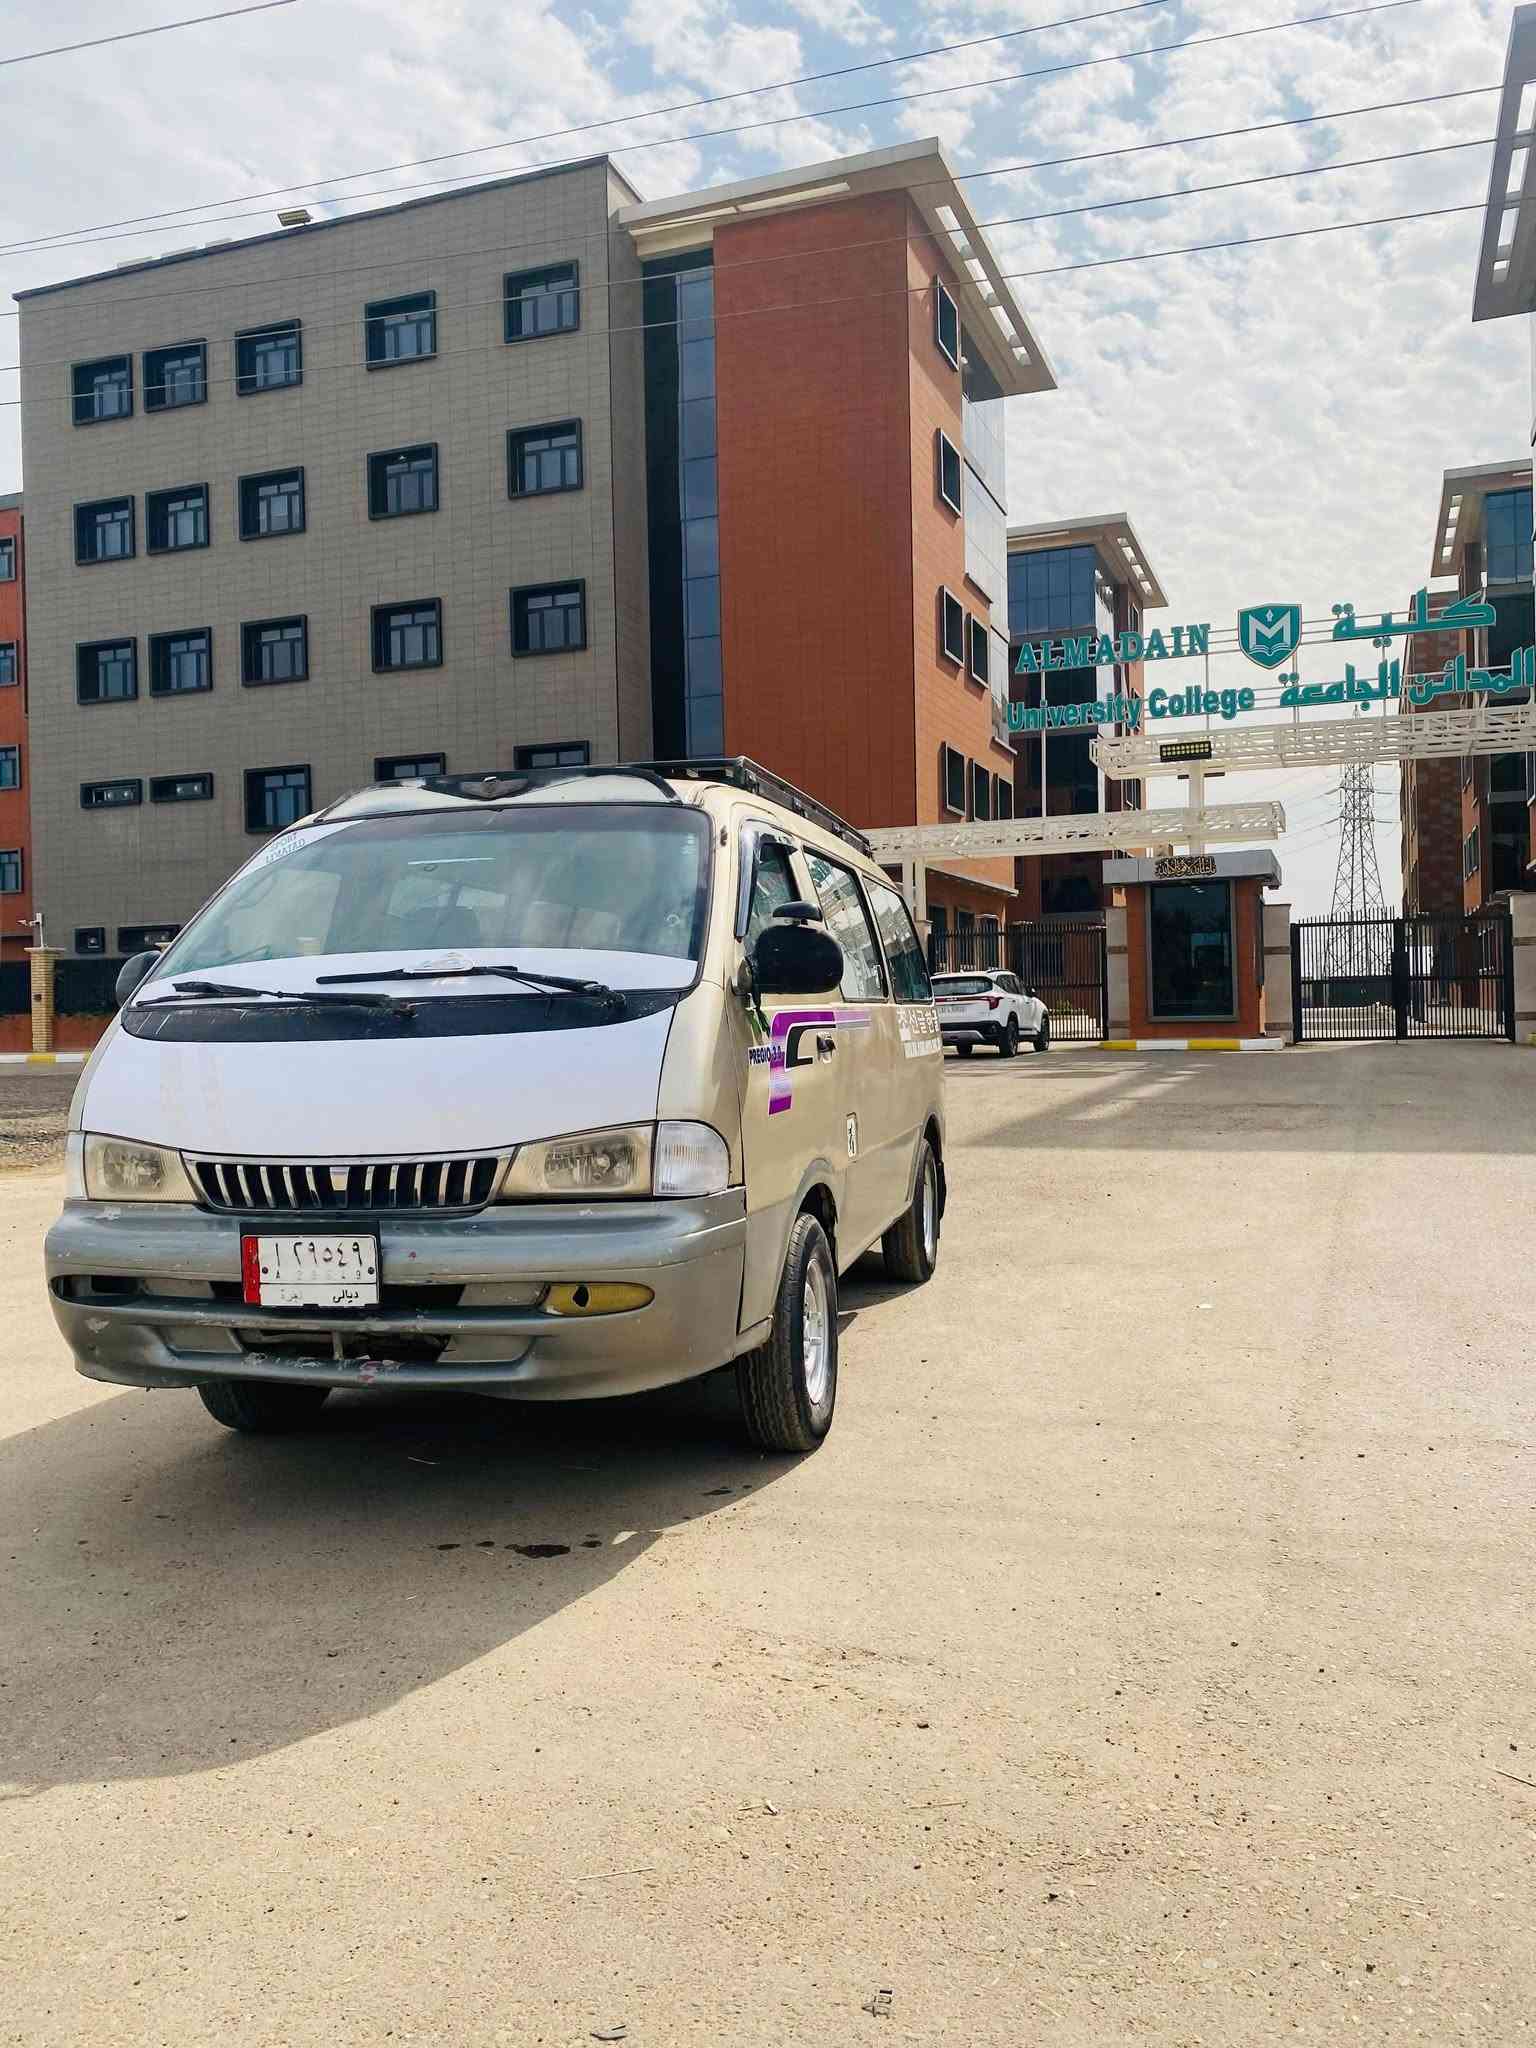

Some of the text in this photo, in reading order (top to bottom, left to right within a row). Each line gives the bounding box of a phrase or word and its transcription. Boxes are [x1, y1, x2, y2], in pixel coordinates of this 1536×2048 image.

[1331, 586, 1496, 648] كلية
[1015, 624, 1211, 673] ALMADAIN
[1278, 644, 1535, 711] المدائن الجامعة
[1007, 685, 1255, 731] University College
